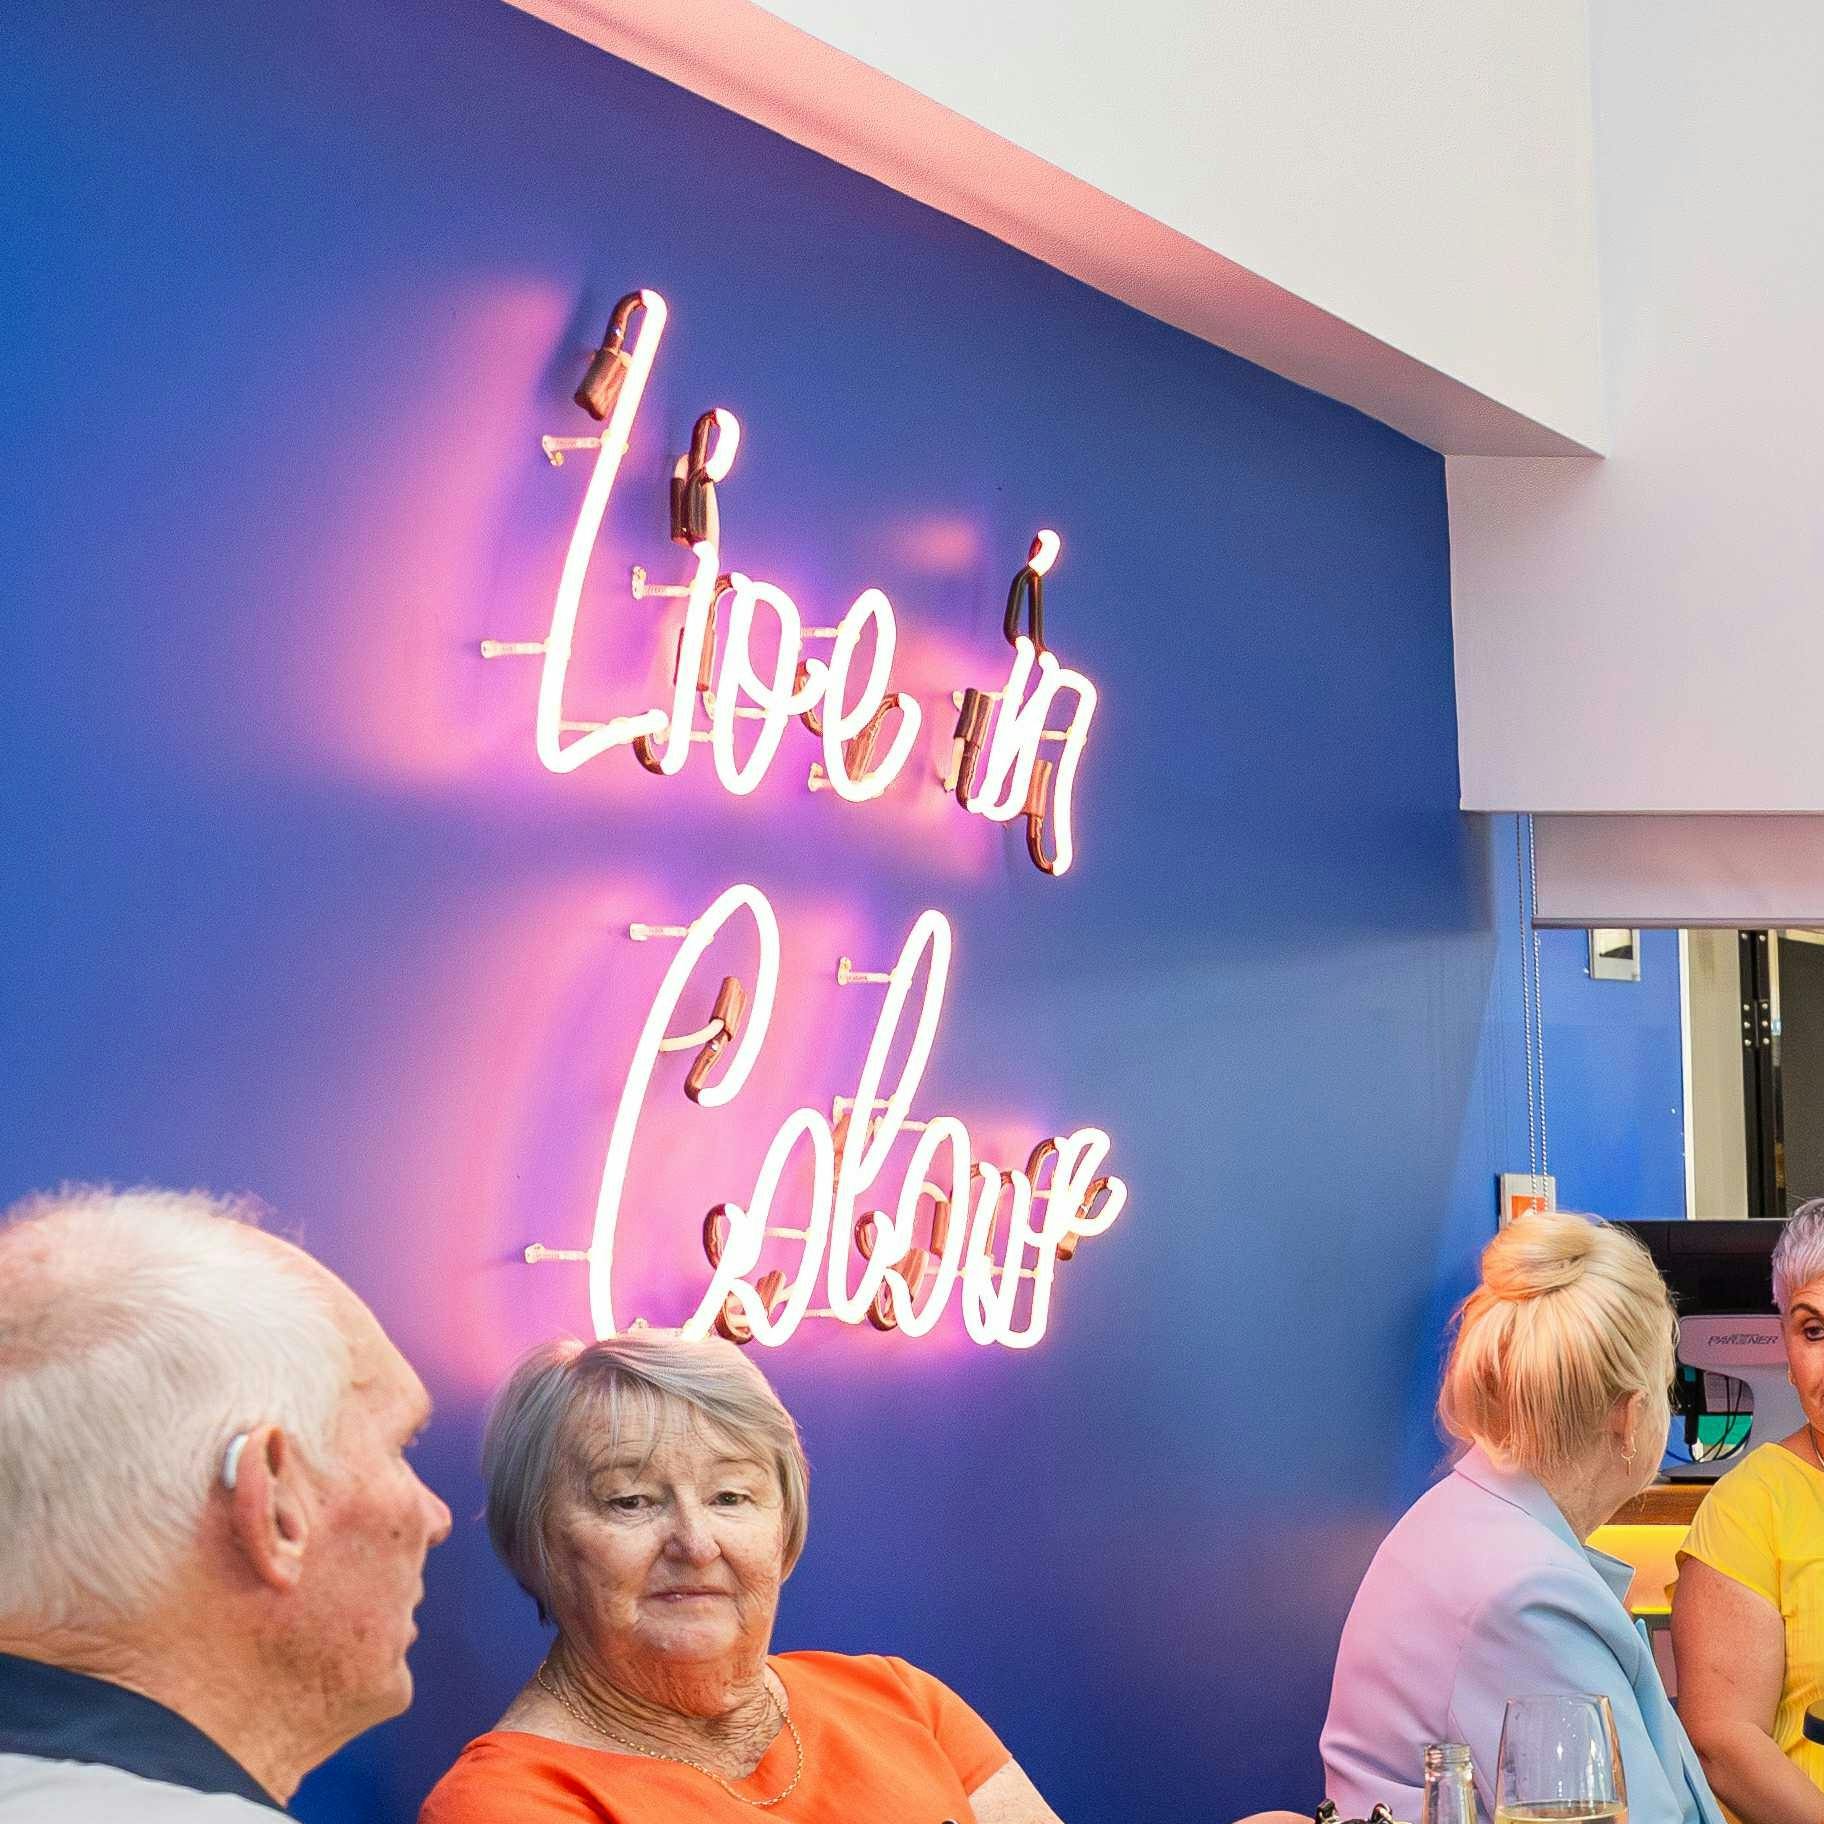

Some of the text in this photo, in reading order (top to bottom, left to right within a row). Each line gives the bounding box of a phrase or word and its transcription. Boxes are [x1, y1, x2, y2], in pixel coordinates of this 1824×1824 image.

[537, 288, 1098, 876] Live in
[589, 883, 1128, 1349] Colour
